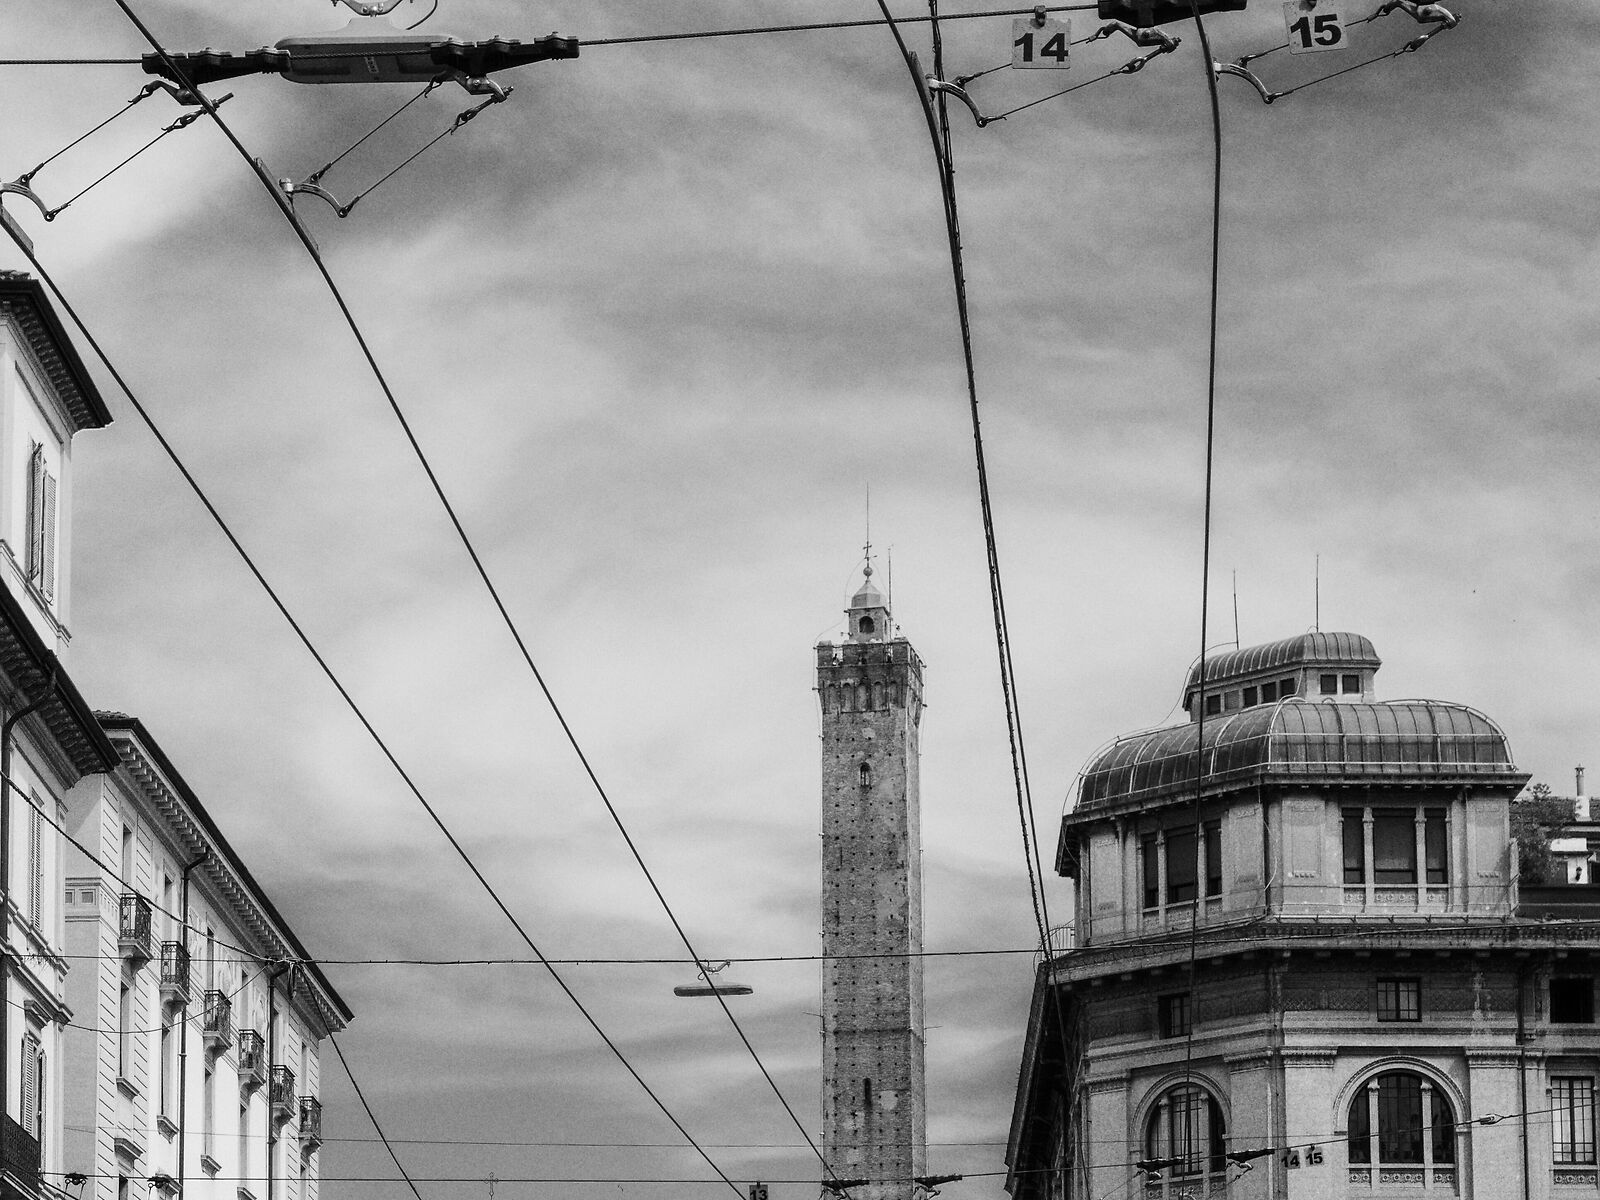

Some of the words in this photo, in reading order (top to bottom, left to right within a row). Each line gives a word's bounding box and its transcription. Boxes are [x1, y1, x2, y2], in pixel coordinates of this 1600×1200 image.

[1290, 13, 1342, 48] 15
[1014, 32, 1069, 63] 14
[1281, 1155, 1300, 1168] 14
[1305, 1152, 1323, 1165] 15
[750, 1189, 768, 1200] 13
